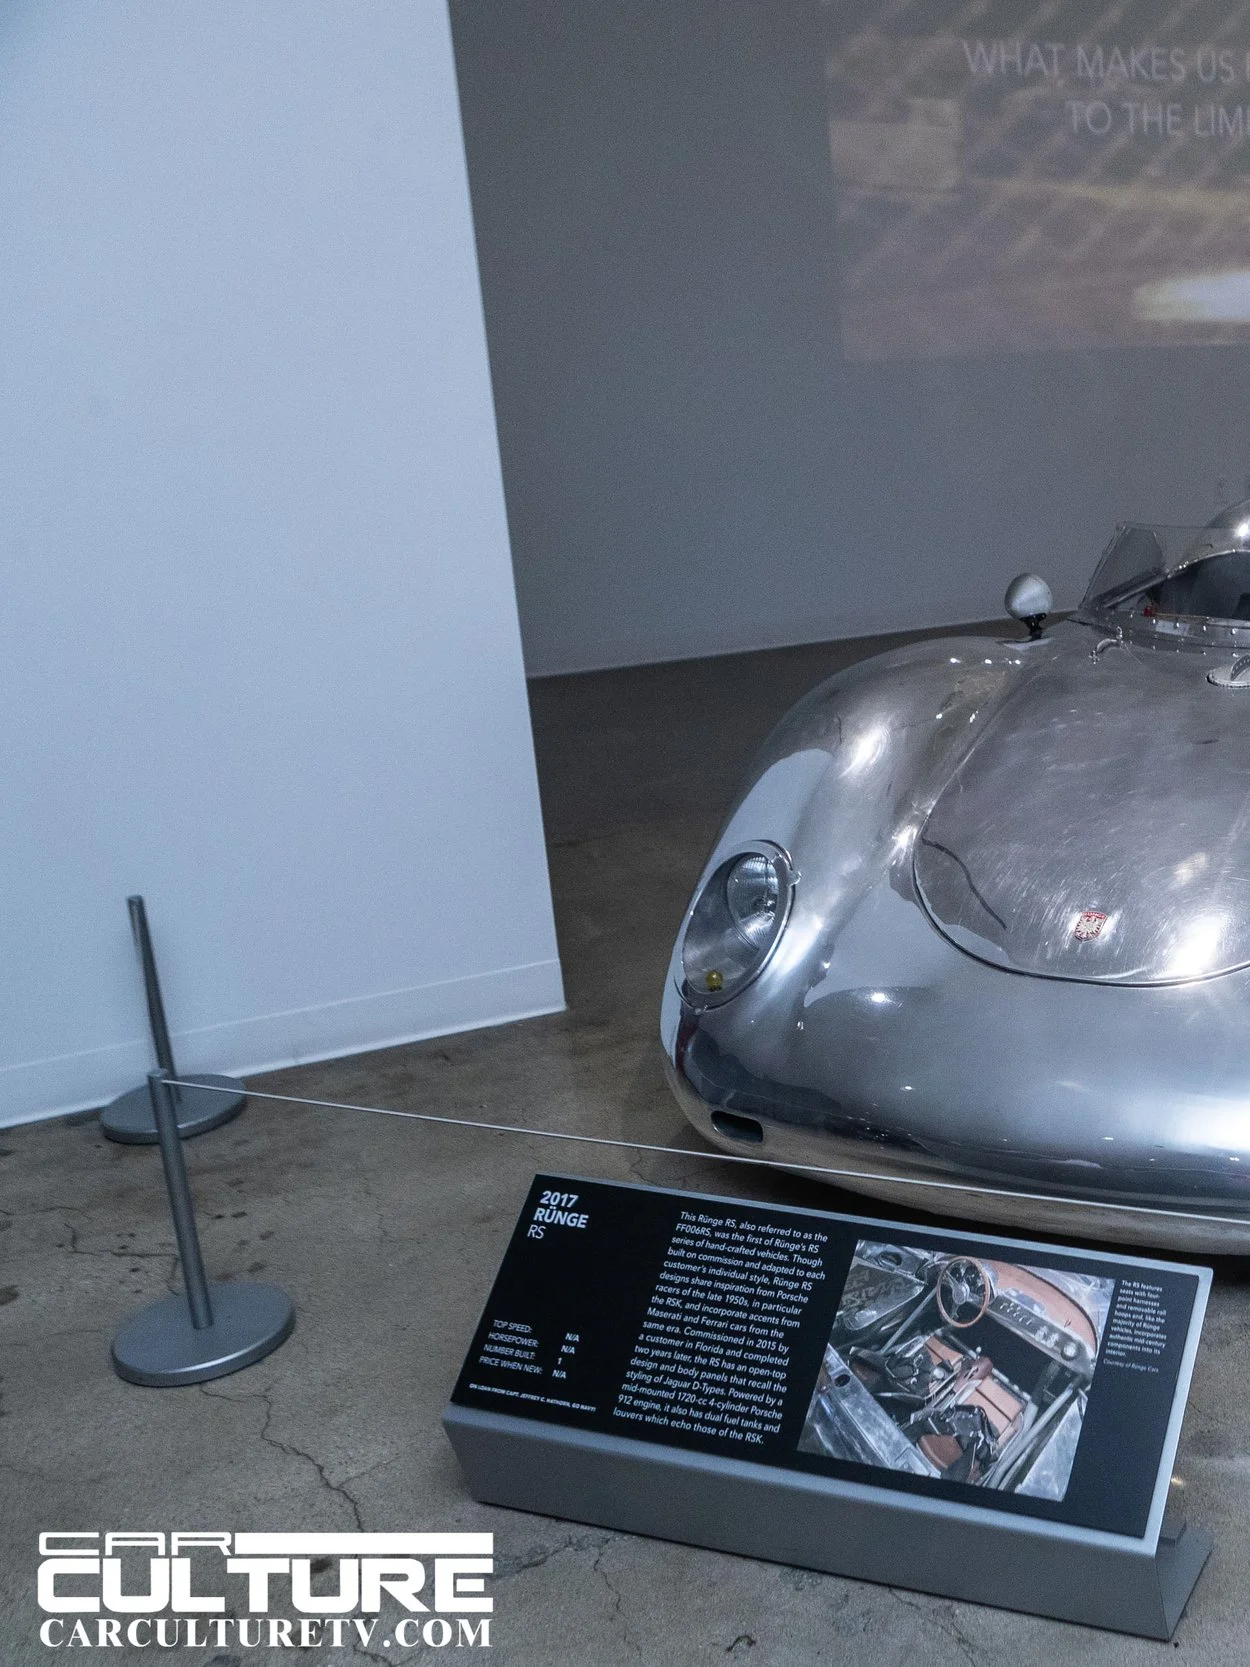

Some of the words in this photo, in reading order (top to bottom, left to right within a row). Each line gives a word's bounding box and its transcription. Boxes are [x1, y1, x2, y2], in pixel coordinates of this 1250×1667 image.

[962, 39, 1065, 77] WHAT
[1077, 45, 1187, 82] MAKES
[1197, 48, 1235, 85] US
[1066, 100, 1112, 136] TO
[1122, 102, 1183, 137] THE
[540, 1191, 579, 1208] 2017
[527, 1224, 546, 1239] RS
[533, 1206, 589, 1228] RÜNGE
[681, 1212, 696, 1221] This
[698, 1214, 724, 1227] Rünge
[725, 1219, 737, 1229] RS,
[739, 1221, 756, 1231] also
[758, 1224, 792, 1236] referred
[793, 1230, 802, 1238] to
[814, 1233, 828, 1242] the
[672, 1237, 694, 1246] series
[696, 1239, 706, 1247] of
[705, 1240, 756, 1256] hand-crafted
[757, 1250, 789, 1261] vehicles.
[793, 1254, 823, 1268] Though
[676, 1223, 712, 1237] FF006RS,
[732, 1232, 745, 1242] the
[746, 1234, 763, 1244] first
[764, 1238, 774, 1246] of
[774, 1239, 806, 1252] Rünge's
[808, 1244, 820, 1254] RS
[664, 1261, 707, 1273] customer's
[708, 1266, 749, 1280] individual
[749, 1275, 770, 1285] style,
[773, 1276, 800, 1290] Rünge
[801, 1281, 813, 1291] RS
[668, 1247, 686, 1257] built
[698, 1254, 744, 1266] commission
[745, 1261, 761, 1269] and
[762, 1263, 796, 1275] adapted
[796, 1269, 805, 1277] to
[806, 1271, 826, 1280] each
[656, 1285, 680, 1294] racers
[682, 1288, 692, 1296] of
[692, 1289, 706, 1299] the
[707, 1291, 722, 1302] late
[726, 1294, 749, 1307] 1950s,
[752, 1299, 760, 1308] in
[761, 1303, 802, 1315] particular
[660, 1271, 690, 1284] designs
[691, 1276, 712, 1287] share
[714, 1280, 755, 1294] inspiration
[756, 1286, 775, 1297] from
[777, 1290, 809, 1303] Porsche
[647, 1307, 682, 1320] Maserati
[683, 1315, 700, 1324] and
[701, 1316, 729, 1328] Ferrari
[730, 1324, 747, 1332] cars
[749, 1324, 769, 1336] from
[770, 1329, 784, 1338] the
[652, 1295, 664, 1304] the
[666, 1297, 682, 1309] RSK,
[685, 1303, 701, 1311] and
[702, 1304, 748, 1319] incorporate
[749, 1314, 780, 1325] accents
[781, 1316, 800, 1328] from
[494, 1320, 508, 1328] TOP
[565, 1333, 579, 1342] N/A
[643, 1322, 665, 1331] same
[666, 1326, 681, 1334] era.
[684, 1327, 745, 1345] Commissioned
[746, 1338, 754, 1346] in
[756, 1339, 777, 1350] 2015
[778, 1343, 789, 1355] by
[484, 1344, 515, 1356] NUMBER
[558, 1357, 562, 1365] 1
[561, 1345, 575, 1354] N/A
[635, 1345, 650, 1354] two
[650, 1349, 672, 1358] years
[673, 1351, 692, 1363] later,
[694, 1355, 708, 1365] the
[709, 1357, 720, 1367] RS
[721, 1359, 735, 1370] has
[749, 1367, 787, 1381] open-top
[646, 1335, 684, 1347] customer
[685, 1340, 693, 1349] in
[695, 1342, 724, 1354] Florida
[726, 1349, 743, 1358] and
[744, 1353, 790, 1366] completed
[479, 1356, 500, 1366] PRICE
[501, 1360, 523, 1370] WHEN
[552, 1370, 566, 1379] N/A
[631, 1357, 658, 1370] design
[660, 1364, 676, 1372] and
[677, 1365, 699, 1379] body
[700, 1372, 728, 1382] panels
[730, 1375, 747, 1386] that
[748, 1380, 772, 1390] recall
[773, 1383, 787, 1393] the
[622, 1383, 676, 1399] mid-mounted
[678, 1392, 707, 1405] 1720-cc
[709, 1398, 749, 1413] 4-cylinder
[750, 1405, 783, 1420] Porsche
[626, 1371, 652, 1384] styling
[654, 1375, 664, 1383] of
[663, 1377, 691, 1389] Jaguar
[692, 1381, 726, 1396] D-Types.
[728, 1388, 765, 1402] Powered
[766, 1394, 777, 1407] by
[613, 1407, 643, 1420] louvers
[645, 1414, 669, 1425] which
[671, 1420, 692, 1430] echo
[694, 1423, 717, 1435] those
[719, 1428, 729, 1437] of
[730, 1430, 743, 1440] the
[745, 1432, 764, 1444] RSK.
[619, 1394, 633, 1405] 912
[634, 1400, 662, 1411] engine,
[664, 1403, 670, 1412] it
[671, 1405, 688, 1415] also
[689, 1408, 703, 1418] has
[704, 1411, 723, 1422] dual
[724, 1414, 740, 1425] fuel
[741, 1419, 762, 1430] tanks
[764, 1424, 781, 1433] and
